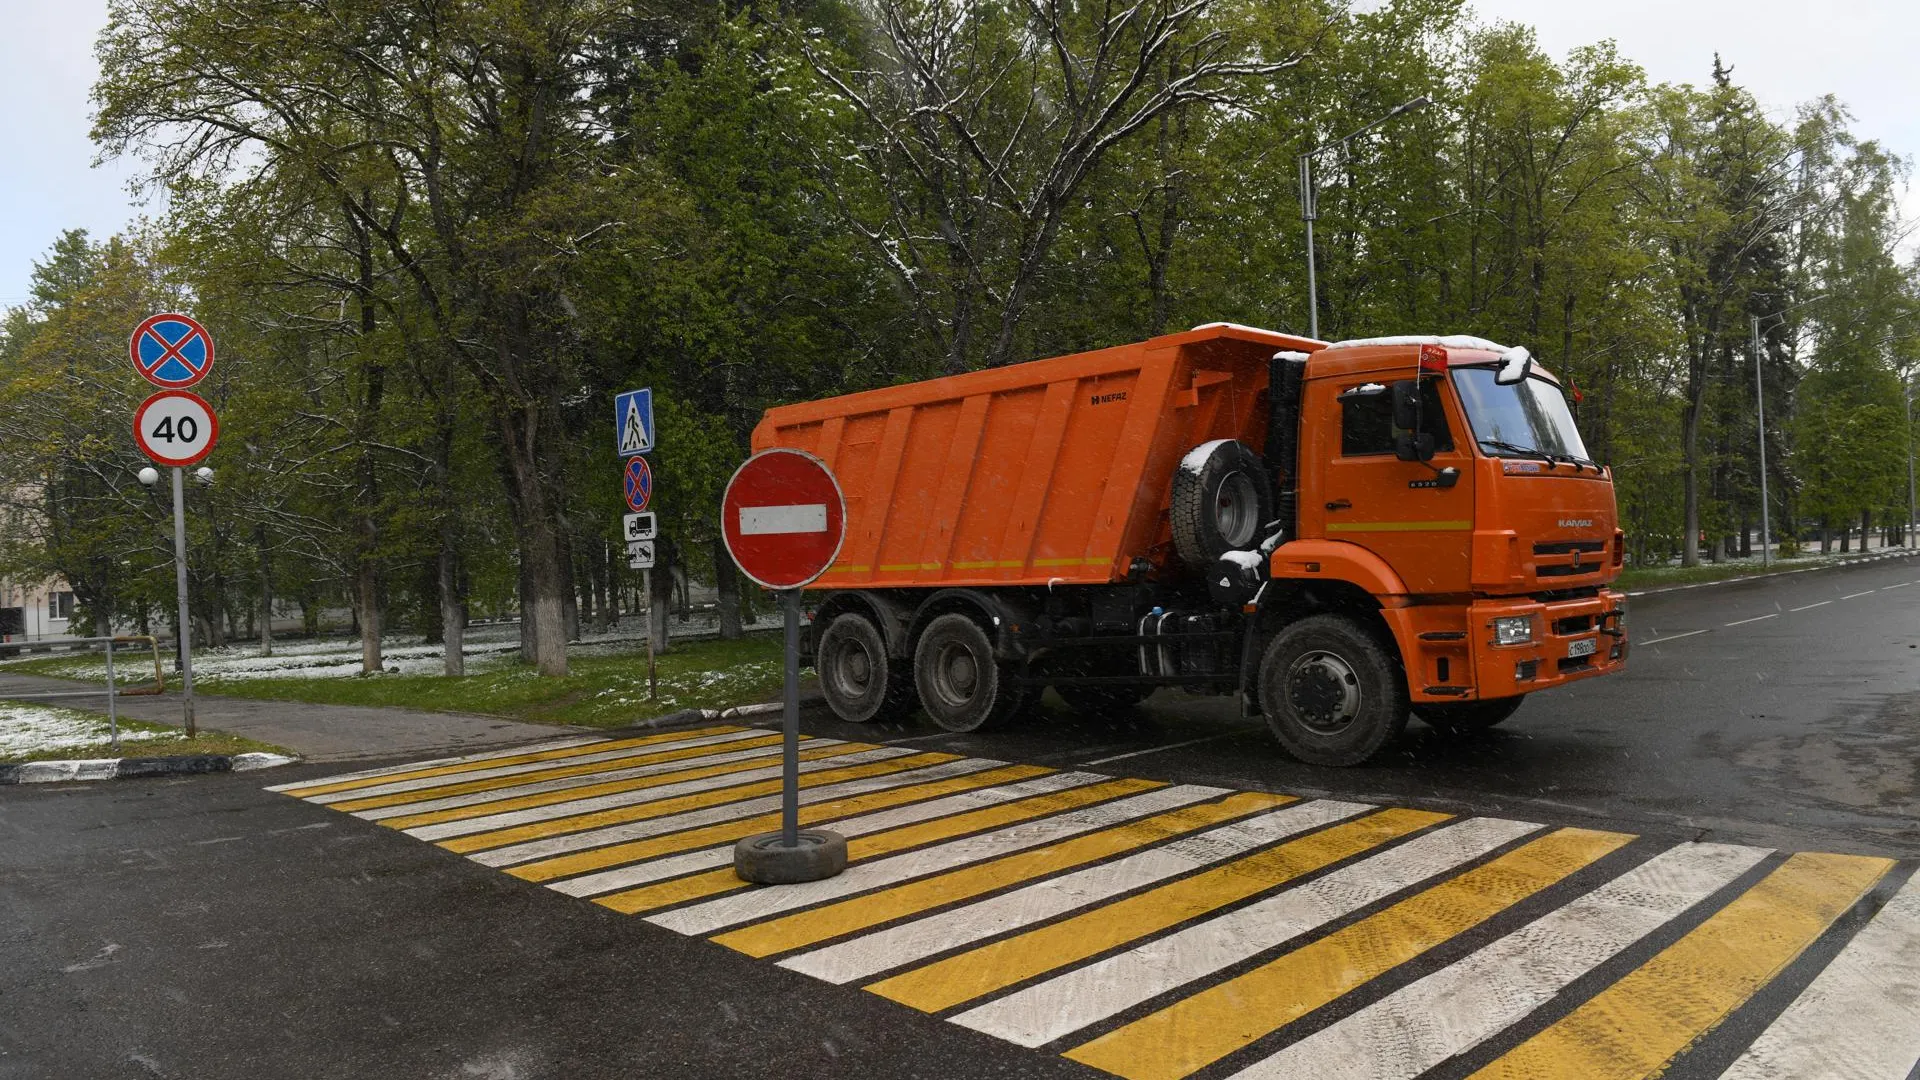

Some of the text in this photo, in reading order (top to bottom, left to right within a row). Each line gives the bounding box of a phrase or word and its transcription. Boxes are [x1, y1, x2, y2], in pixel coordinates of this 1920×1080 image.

[1101, 392, 1127, 404] NEFAZ
[152, 416, 198, 443] 40
[1558, 519, 1593, 528] KAMAZ
